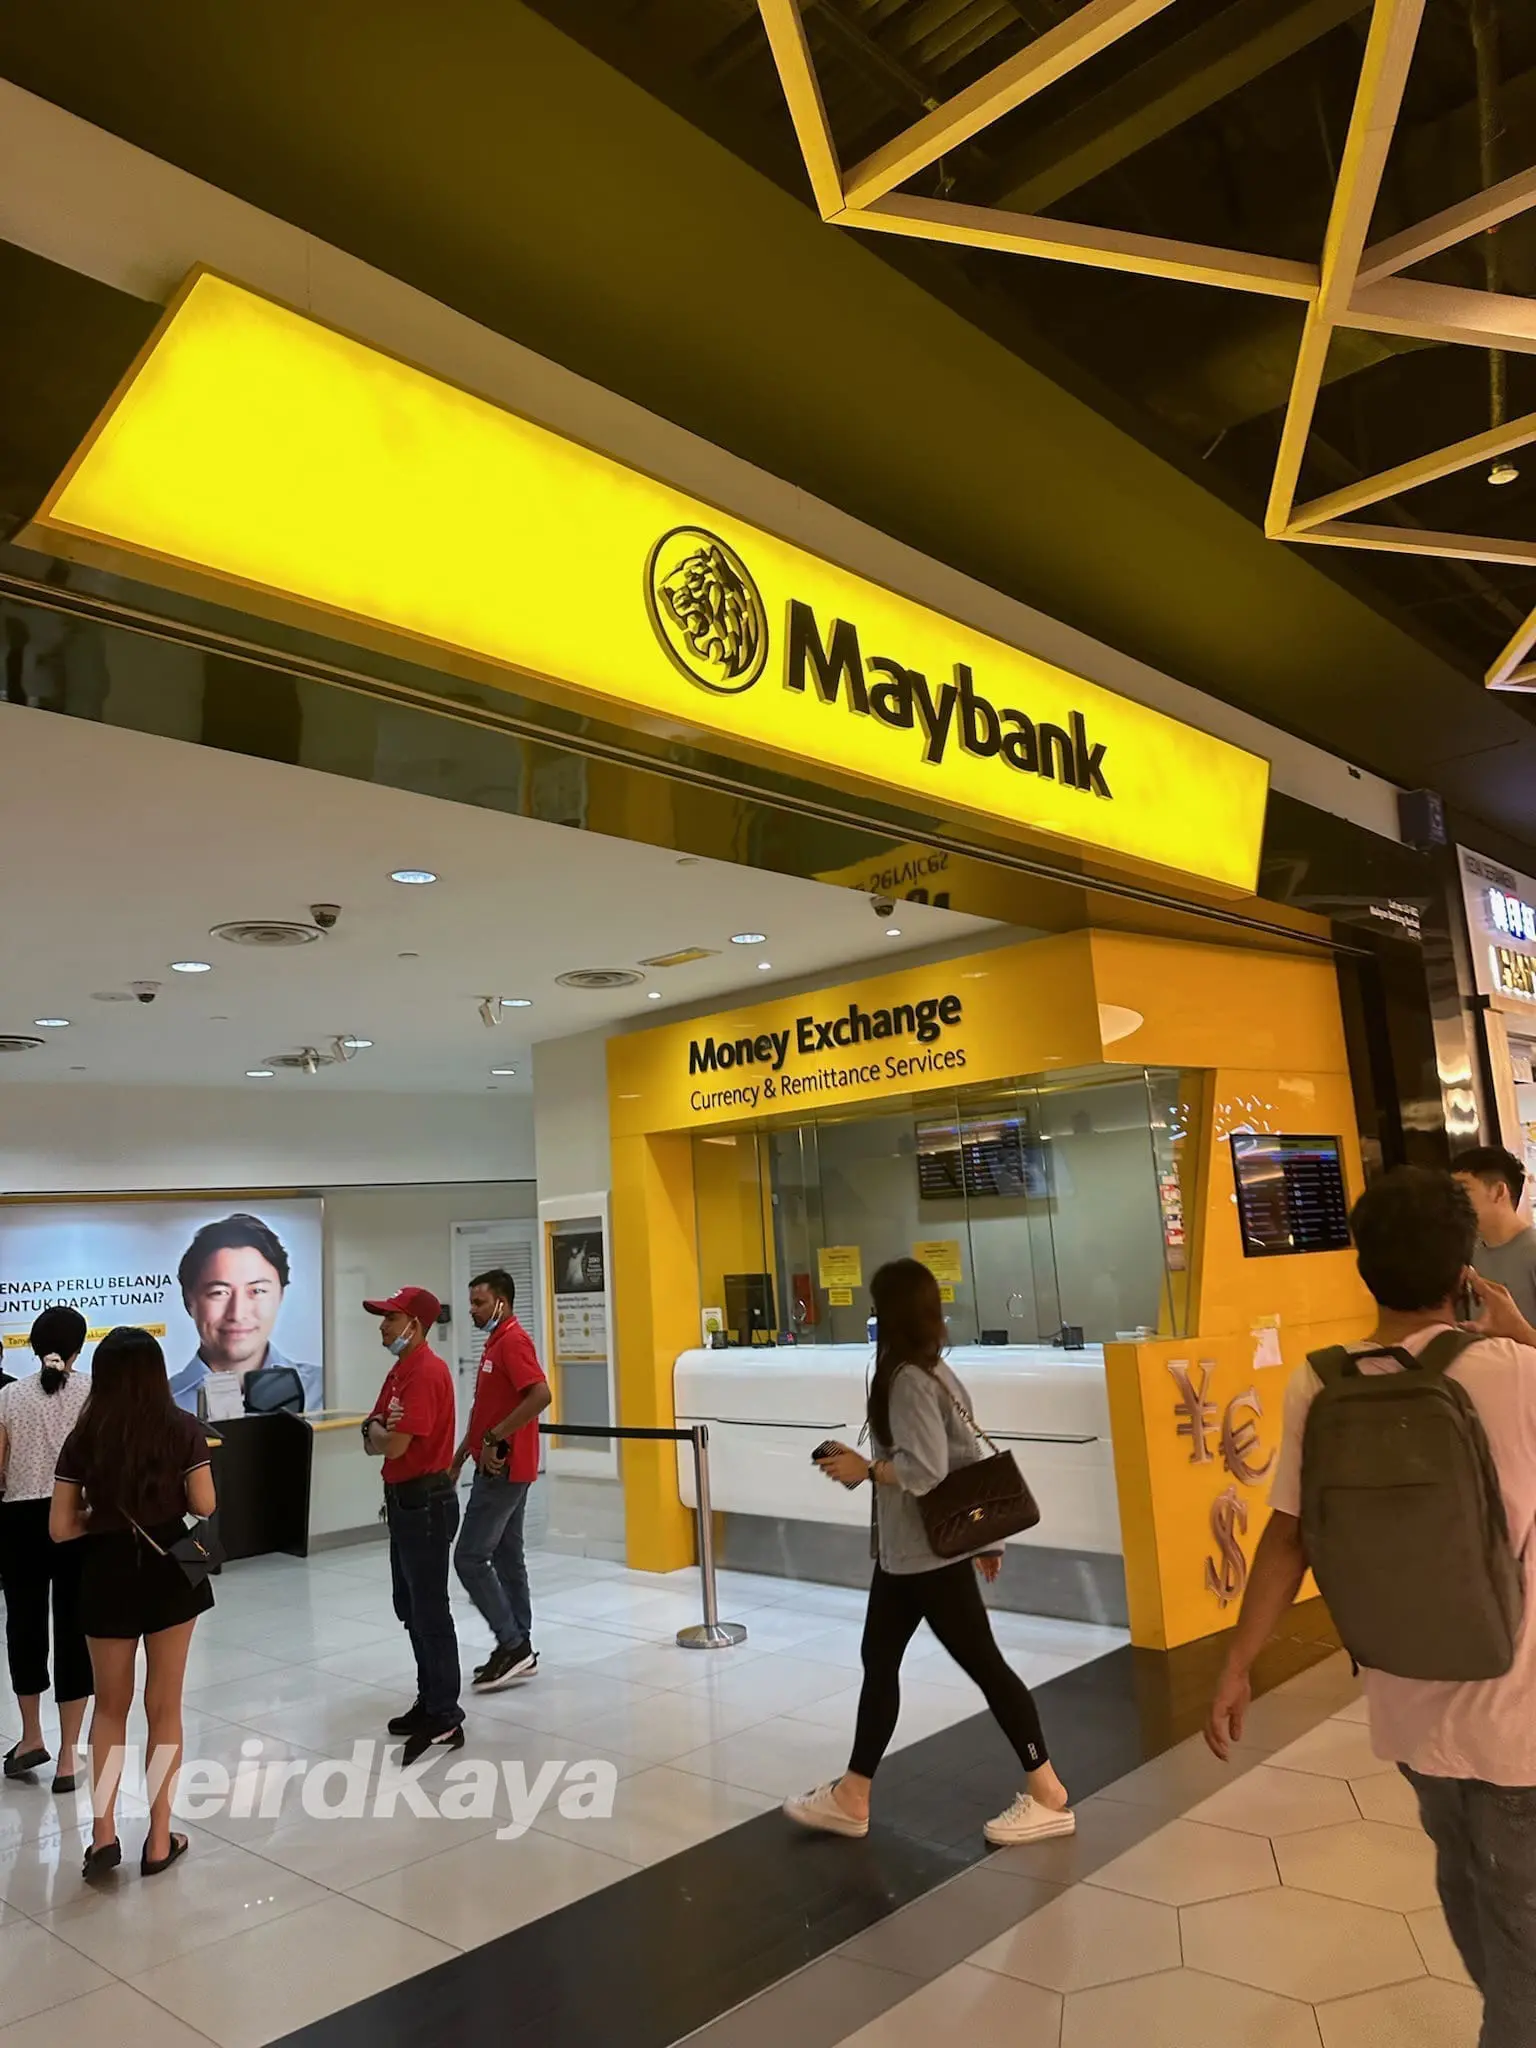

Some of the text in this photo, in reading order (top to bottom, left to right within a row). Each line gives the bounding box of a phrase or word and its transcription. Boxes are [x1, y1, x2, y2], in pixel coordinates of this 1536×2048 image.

[782, 597, 1113, 800] Maybank
[688, 994, 963, 1075] Money Exchange
[690, 1048, 967, 1111] Currency & Remittance Services
[57, 1278, 105, 1291] PERLU
[108, 1274, 172, 1288] BELANJA
[57, 1294, 108, 1308] DAPAT
[109, 1291, 165, 1306] TUNAI?
[1166, 1359, 1220, 1465] ¥
[1219, 1384, 1277, 1487] €
[1205, 1485, 1247, 1607] $
